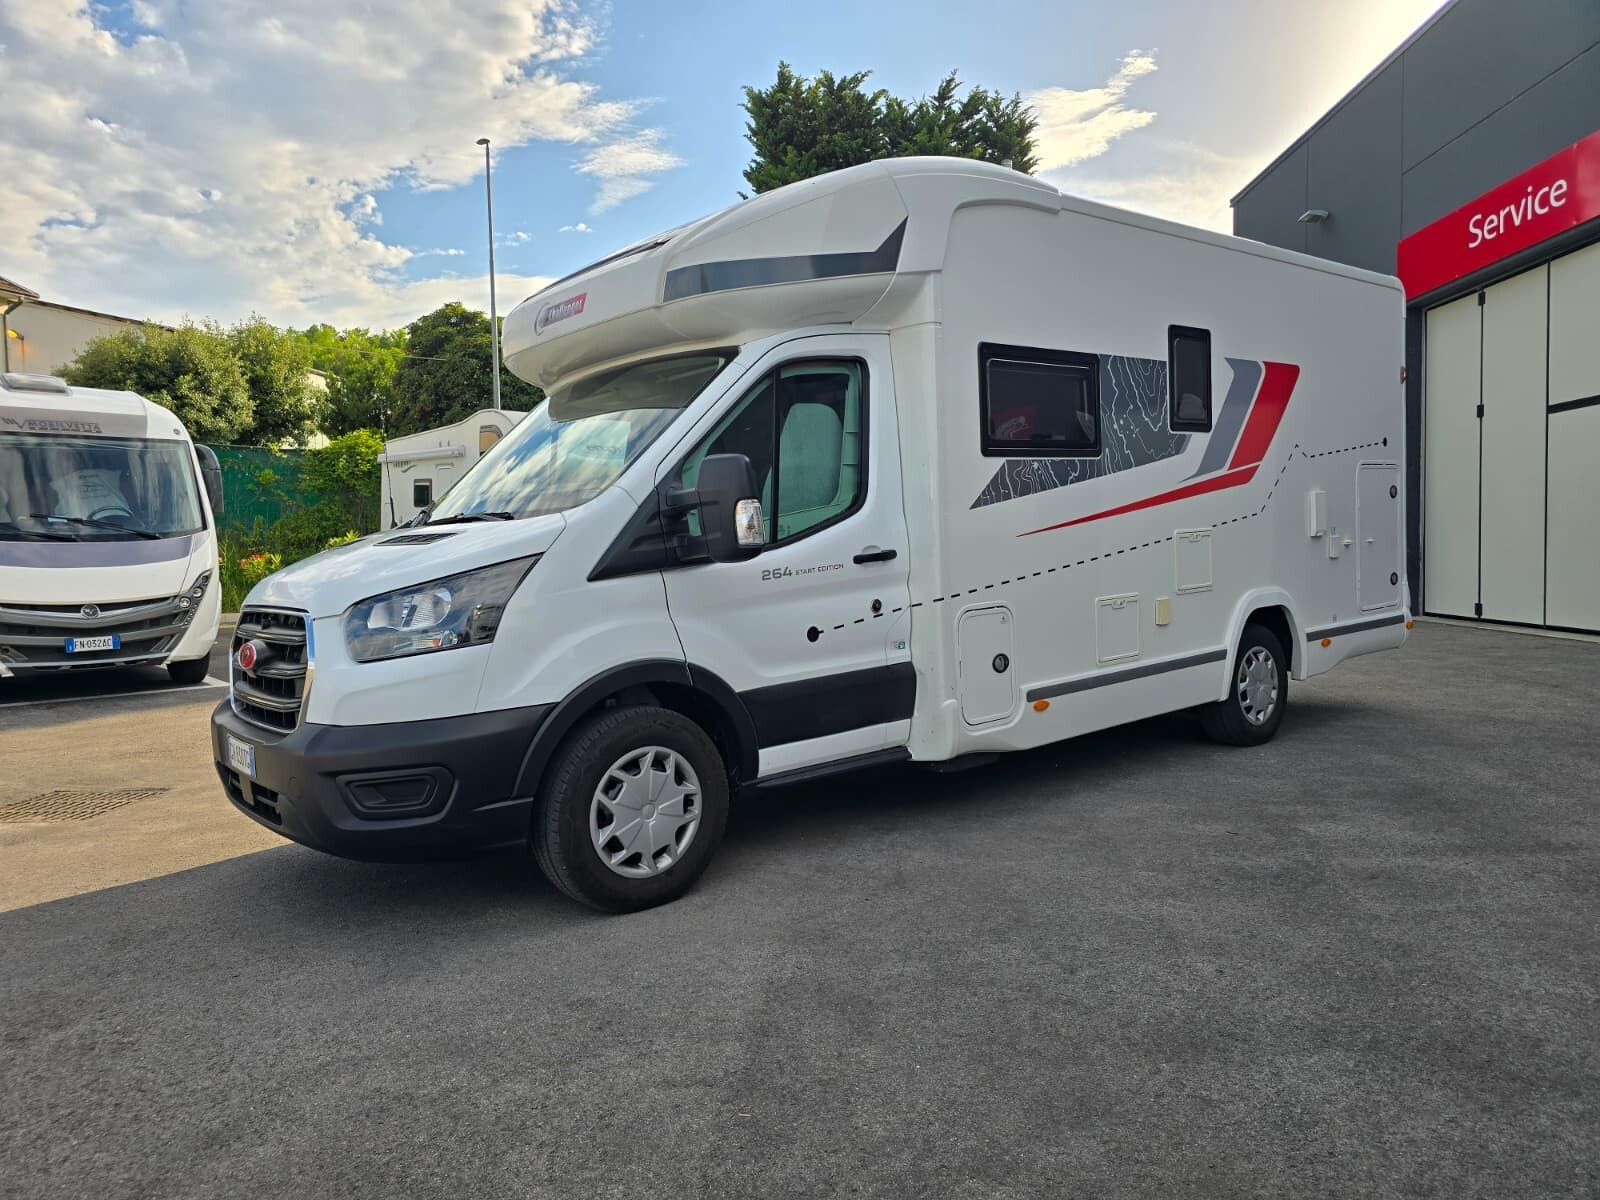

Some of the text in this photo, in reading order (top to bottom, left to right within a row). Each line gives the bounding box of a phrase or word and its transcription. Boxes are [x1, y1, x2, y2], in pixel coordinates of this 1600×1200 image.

[1468, 179, 1568, 249] Service
[761, 566, 793, 581] 264
[817, 563, 844, 572] EDITION
